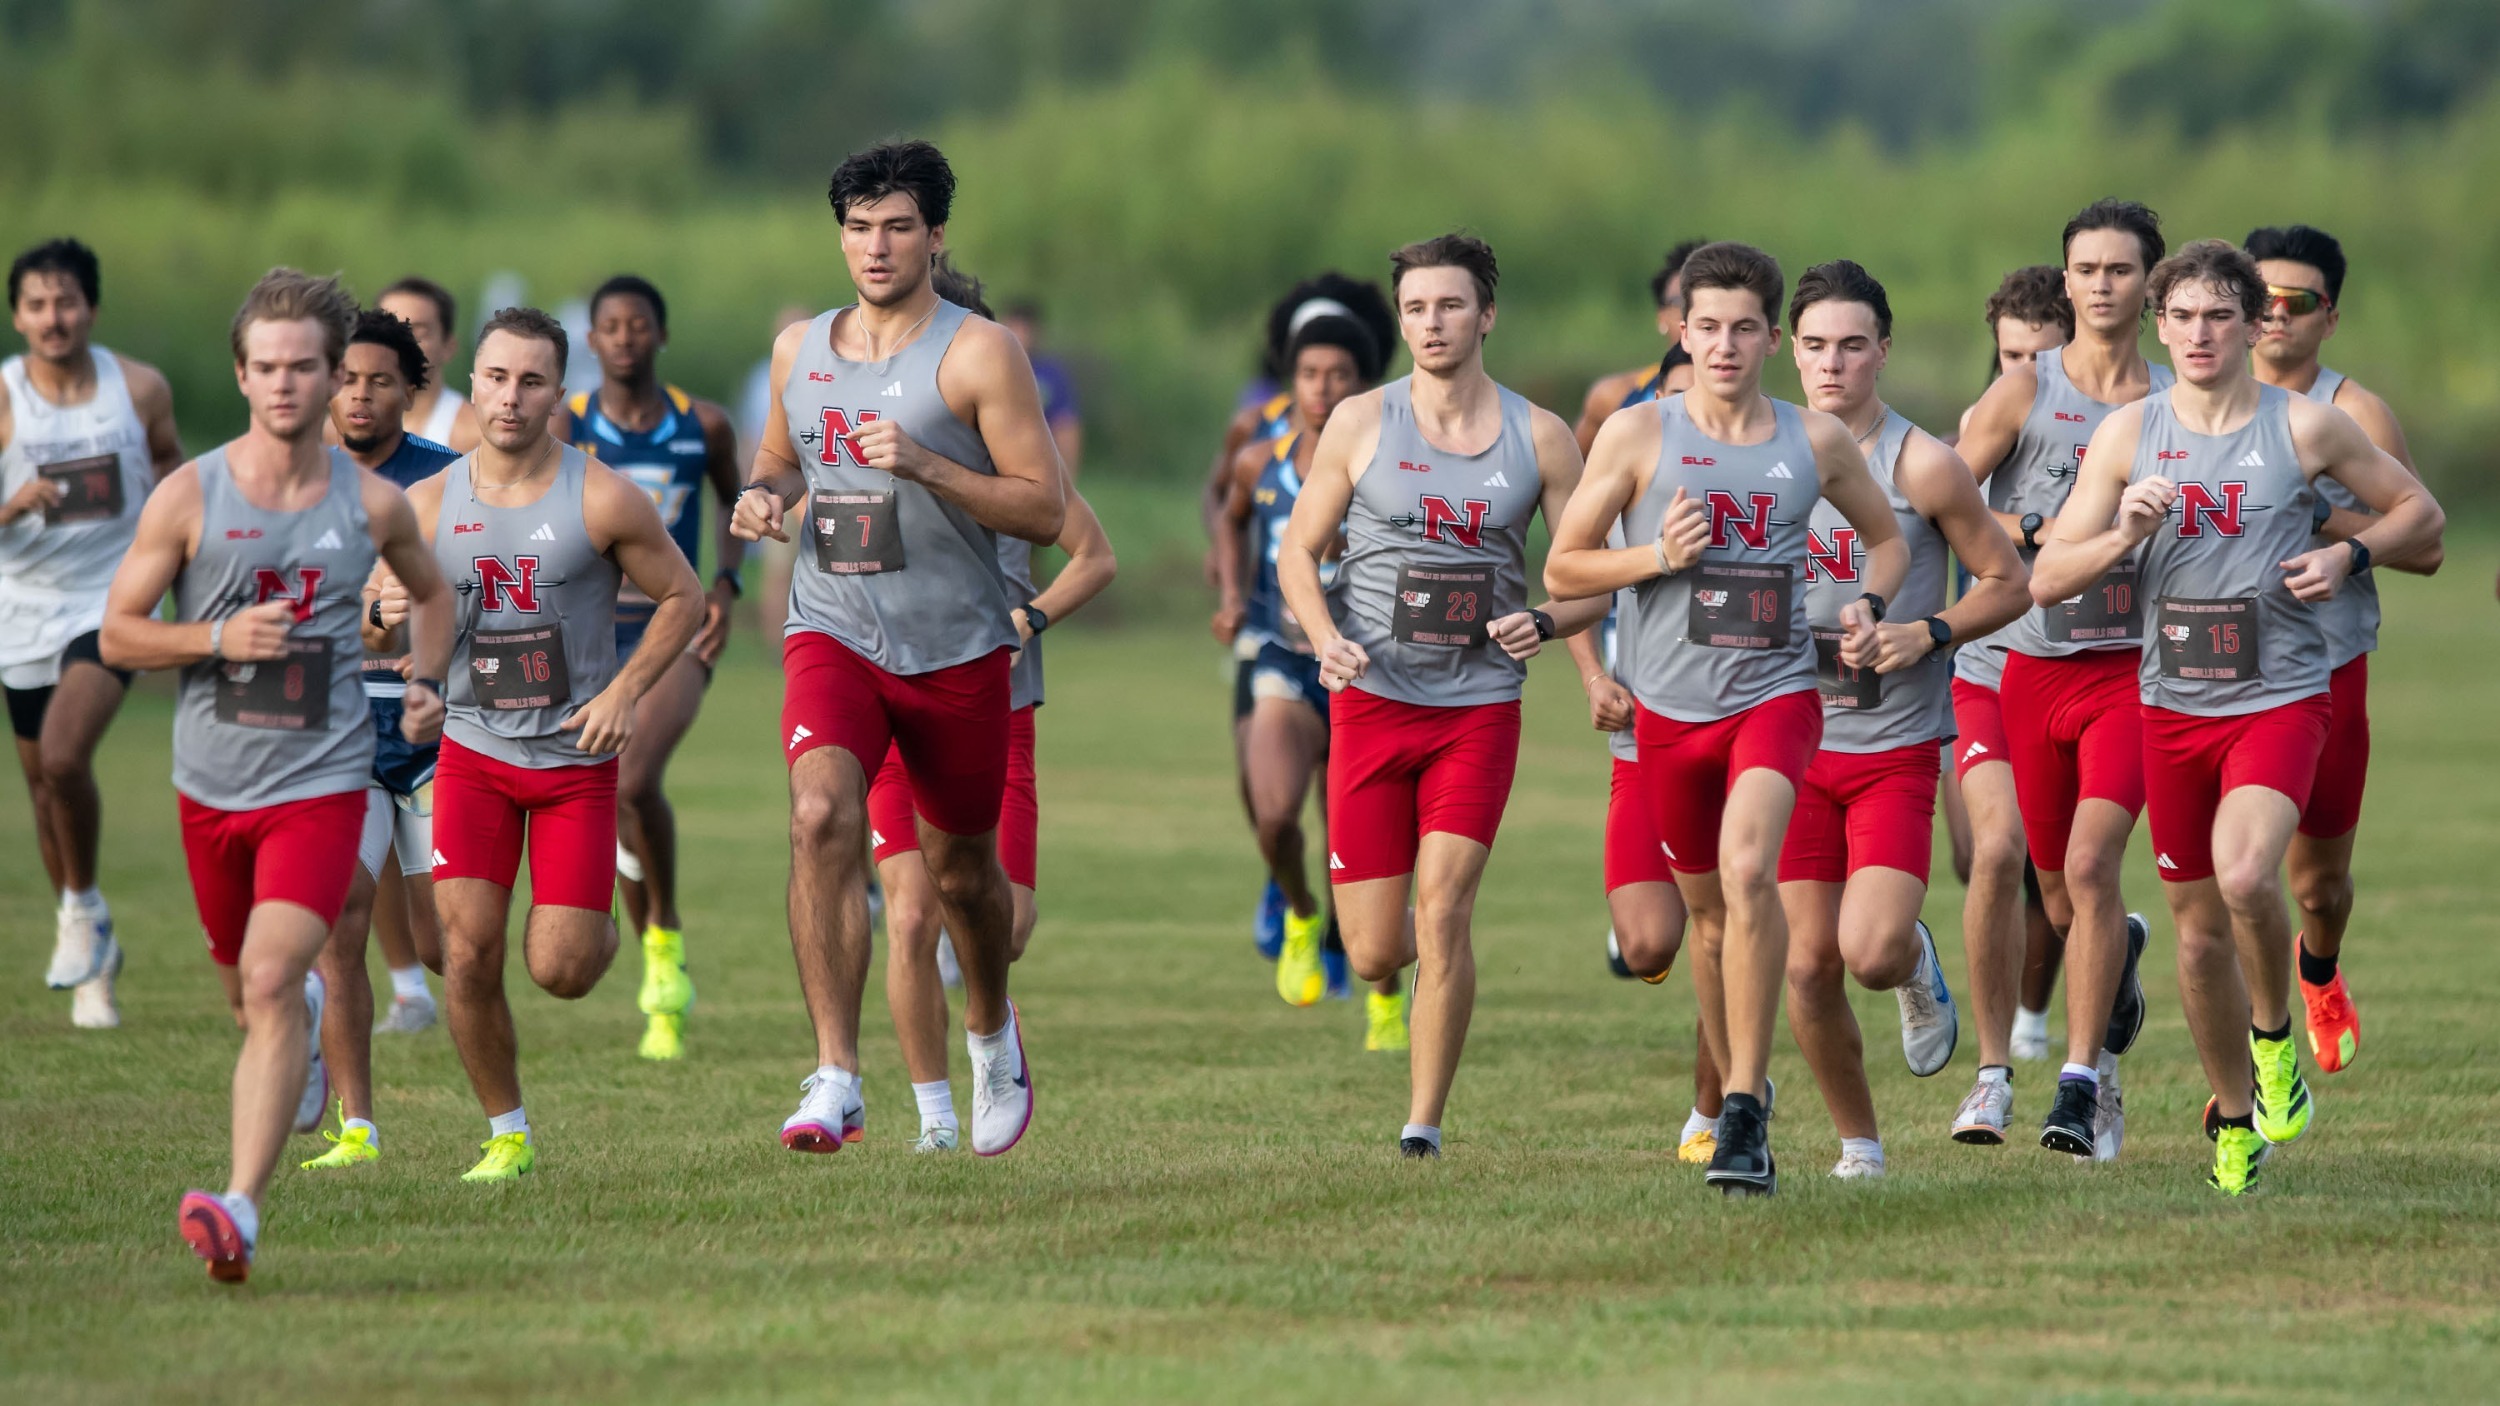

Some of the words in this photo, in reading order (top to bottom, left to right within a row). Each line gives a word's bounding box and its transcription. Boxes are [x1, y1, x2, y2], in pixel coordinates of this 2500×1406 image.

[808, 372, 835, 382] SLC
[2055, 412, 2086, 422] SLC
[819, 406, 880, 468] N
[1399, 461, 1432, 472] SLC
[1682, 456, 1716, 466] SLC
[2158, 450, 2190, 460] SLC
[1420, 493, 1491, 549] N
[1705, 489, 1777, 551] N
[2176, 481, 2247, 538] N
[454, 523, 485, 534] SLC
[857, 515, 870, 547] 7
[1805, 527, 1859, 583] N
[252, 565, 326, 625] N
[473, 554, 541, 614] N
[2103, 584, 2131, 614] 10
[1446, 591, 1477, 622] 23
[1748, 589, 1778, 623] 19
[2208, 623, 2239, 654] 15
[518, 650, 550, 683] 16
